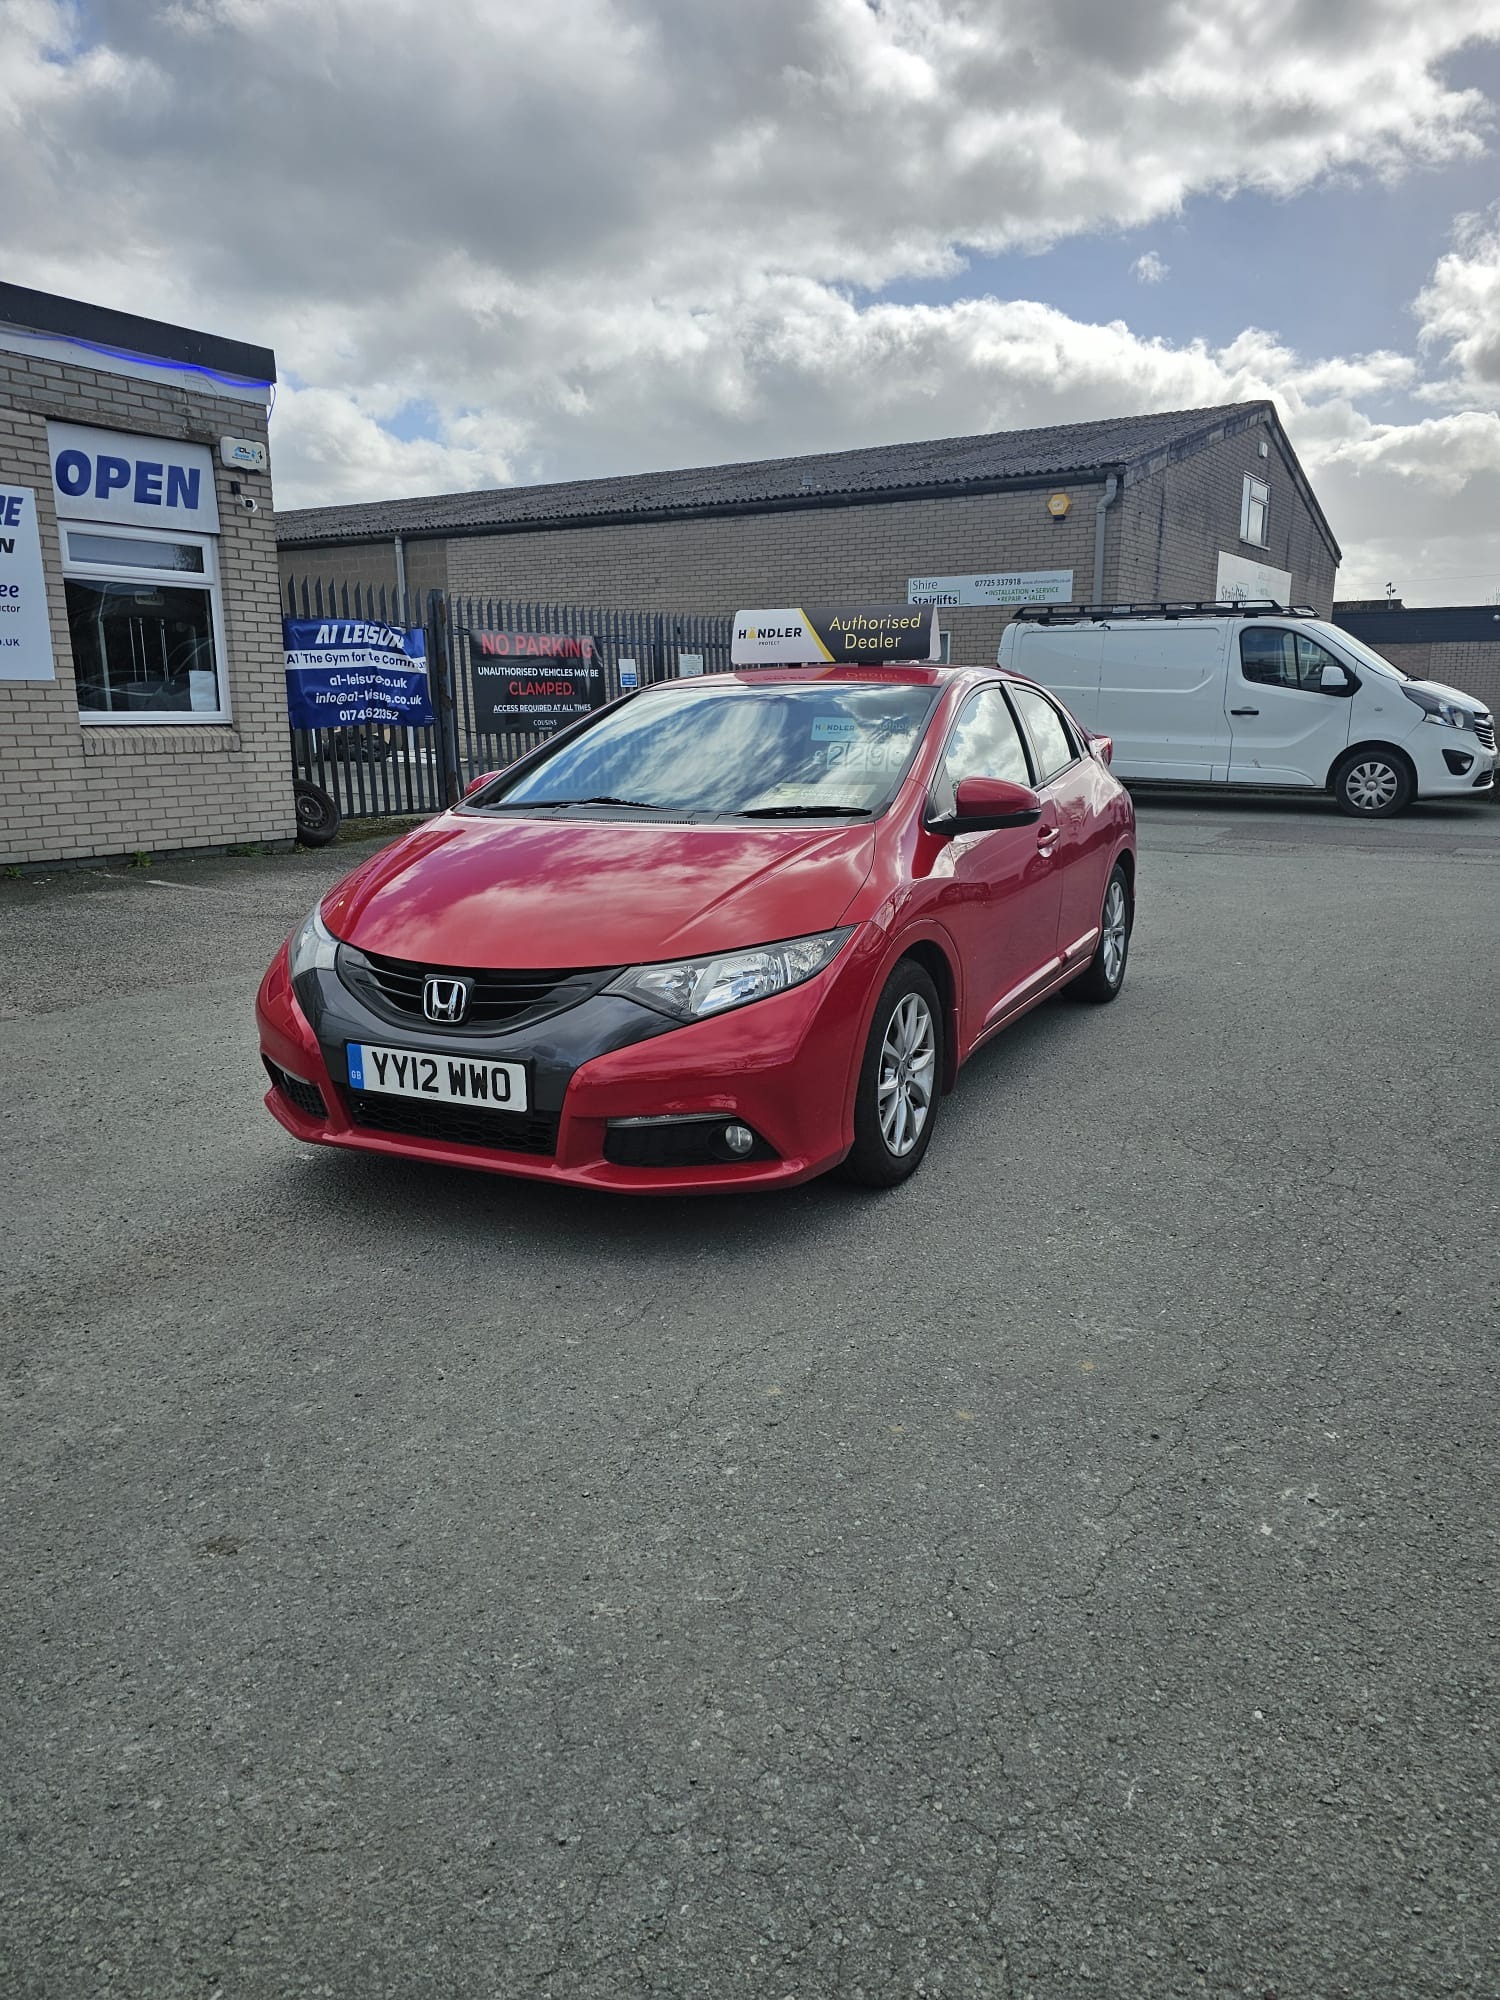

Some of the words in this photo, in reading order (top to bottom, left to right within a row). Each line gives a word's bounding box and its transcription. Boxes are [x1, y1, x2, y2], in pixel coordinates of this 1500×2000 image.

[56, 449, 200, 510] OPEN
[0, 494, 24, 527] E
[912, 580, 938, 590] Shire
[974, 580, 995, 588] 07725
[996, 578, 1021, 586] 337918
[989, 587, 1029, 596] INSTALLATION
[1035, 586, 1059, 594] SERVICE
[912, 594, 958, 605] Stairlifts
[0, 605, 21, 613] ctor
[829, 612, 921, 631] Authorised
[0, 638, 20, 647] .UK
[481, 633, 509, 656] NO
[515, 636, 592, 658] PARKING
[845, 631, 901, 649] Dealer
[325, 652, 348, 666] Gym
[351, 651, 366, 662] for
[478, 667, 538, 676] UNAUTHORISED
[539, 668, 573, 677] VEHICLES
[574, 668, 589, 677] MAY
[590, 669, 599, 677] BE
[509, 681, 575, 696] CLAMPED.
[493, 704, 519, 712] ACCESS
[520, 704, 552, 712] REQUIRED
[574, 703, 591, 711] TIMES
[351, 1070, 362, 1080] GB
[371, 1052, 440, 1093] YY12
[447, 1061, 511, 1102] WWO
